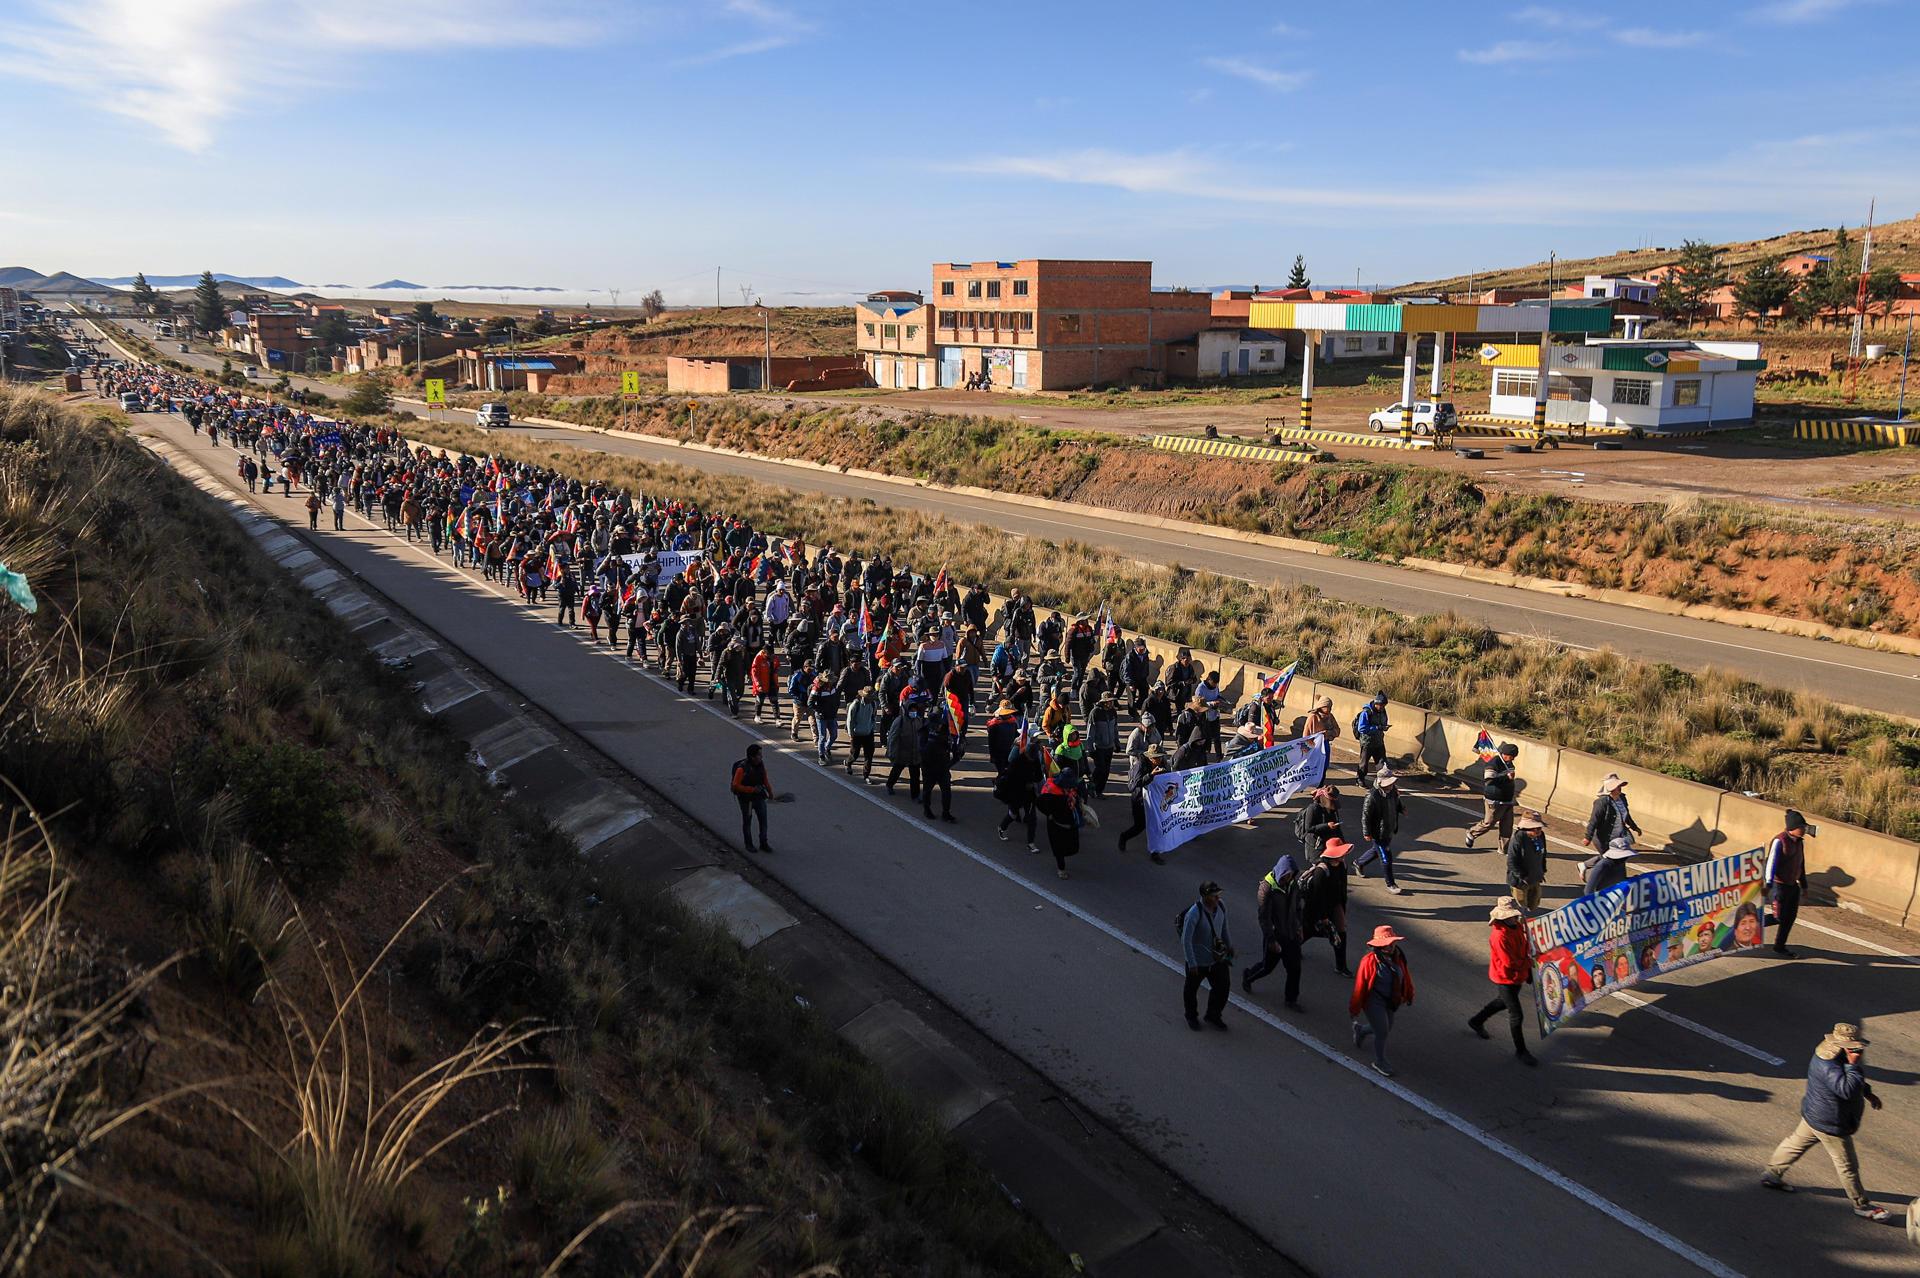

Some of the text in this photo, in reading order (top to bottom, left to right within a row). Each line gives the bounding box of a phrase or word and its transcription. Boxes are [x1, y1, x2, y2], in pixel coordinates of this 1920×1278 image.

[1188, 784, 1202, 797] DEL
[1202, 774, 1233, 793] TROPICO
[1232, 771, 1242, 784] DE
[1243, 753, 1290, 781] COCHABAMBA
[1212, 803, 1231, 812] VIVIR
[1626, 878, 1651, 912] DE
[1654, 850, 1765, 905] GREMIALES
[1687, 889, 1741, 917] TROPICO
